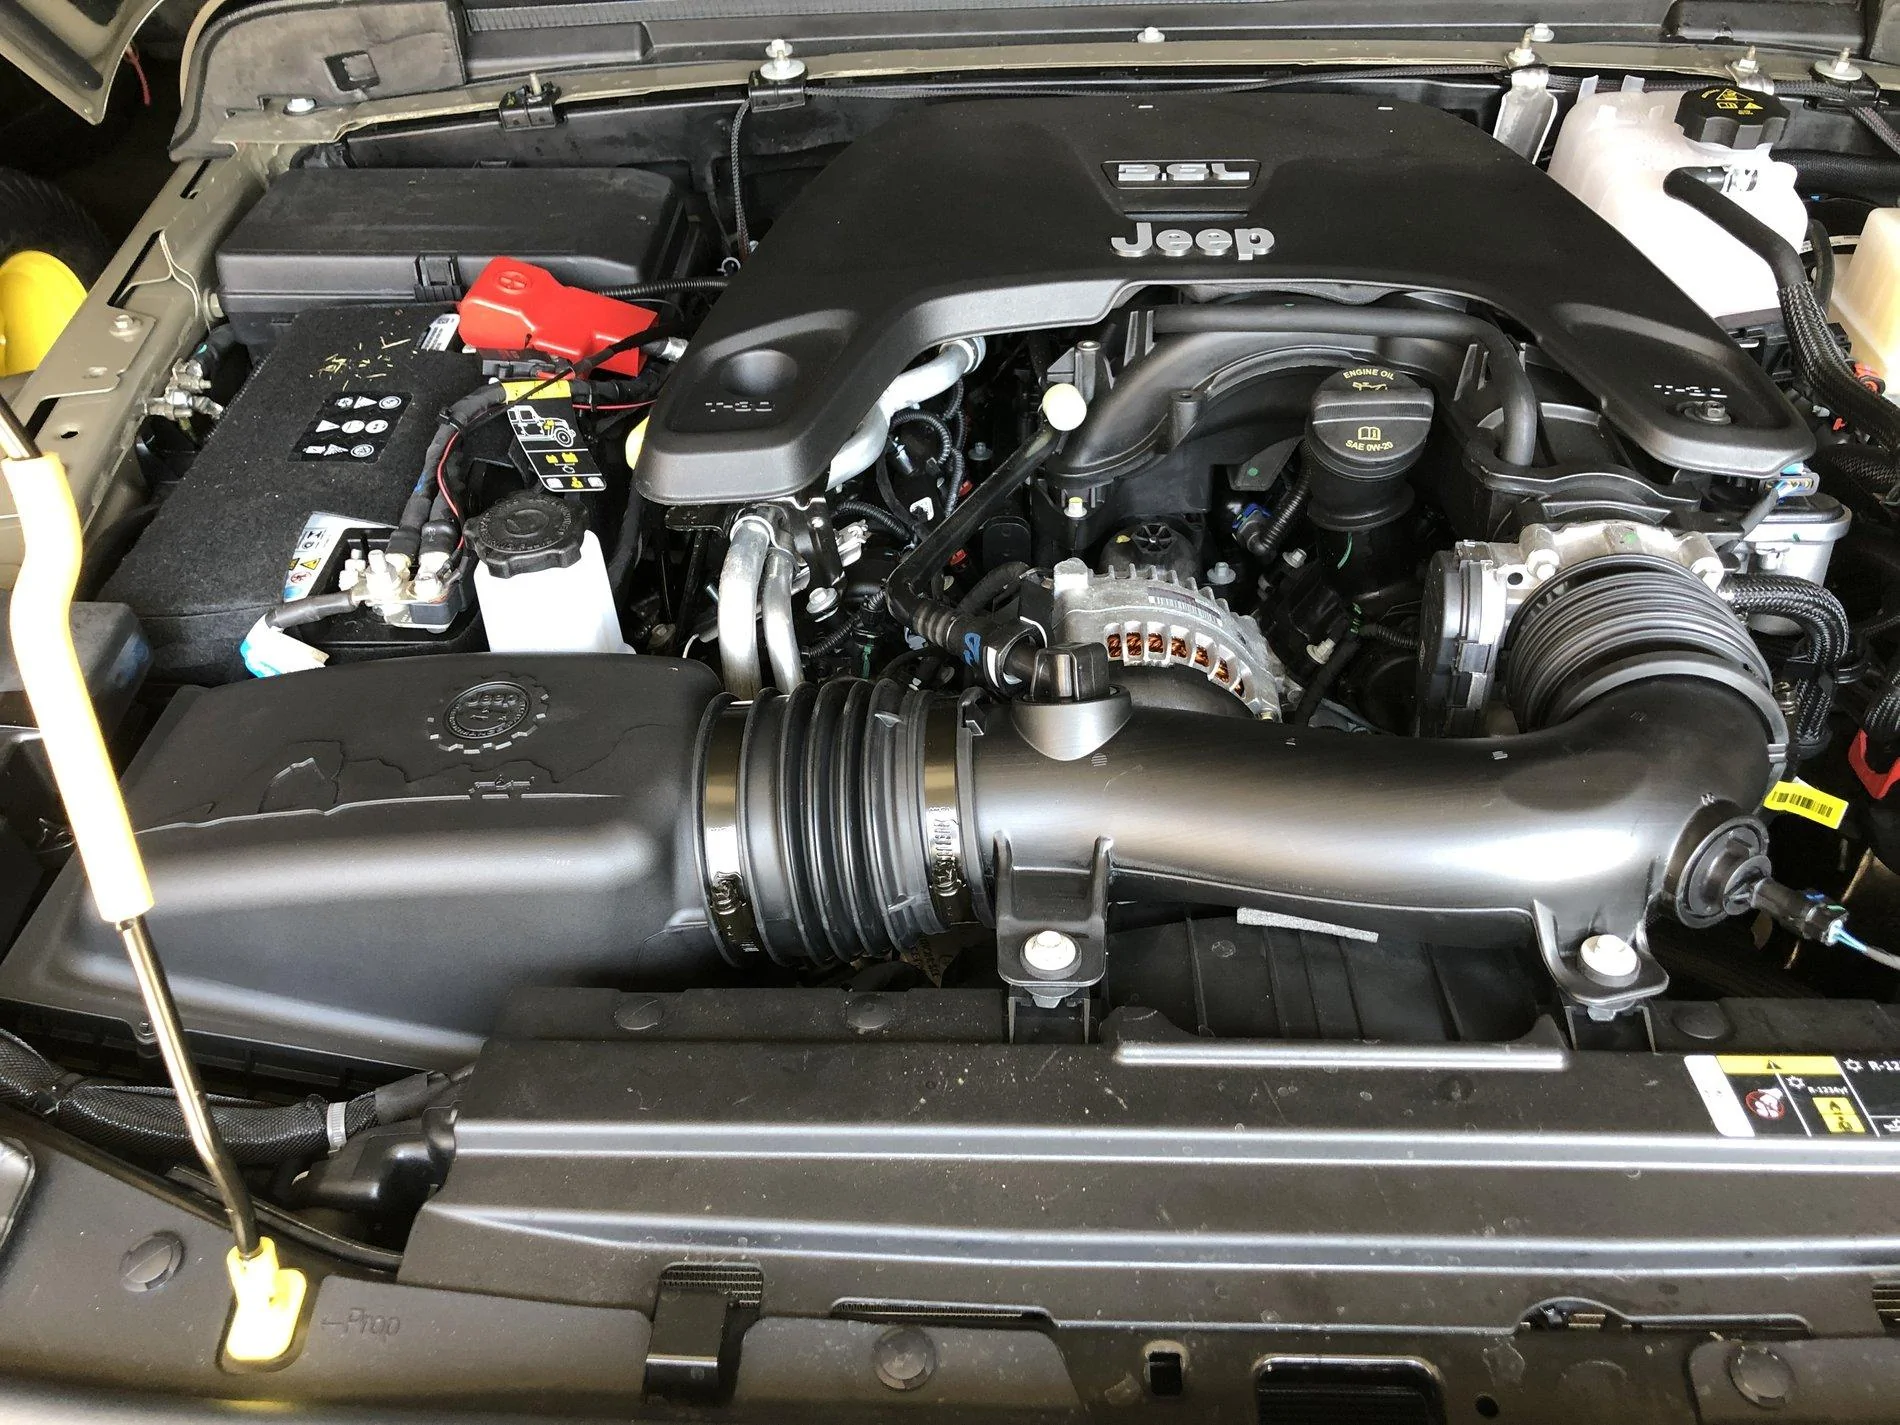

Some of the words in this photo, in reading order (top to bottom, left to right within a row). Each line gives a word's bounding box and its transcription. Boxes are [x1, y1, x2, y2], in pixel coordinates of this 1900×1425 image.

[1111, 222, 1275, 260] Jeep
[1343, 368, 1379, 379] ENGINE
[1380, 369, 1394, 380] OIL
[1345, 440, 1365, 451] SAE
[1366, 441, 1394, 452] 0W-20
[1807, 1085, 1849, 1095] R-1234yf
[344, 1307, 401, 1343] Prop
